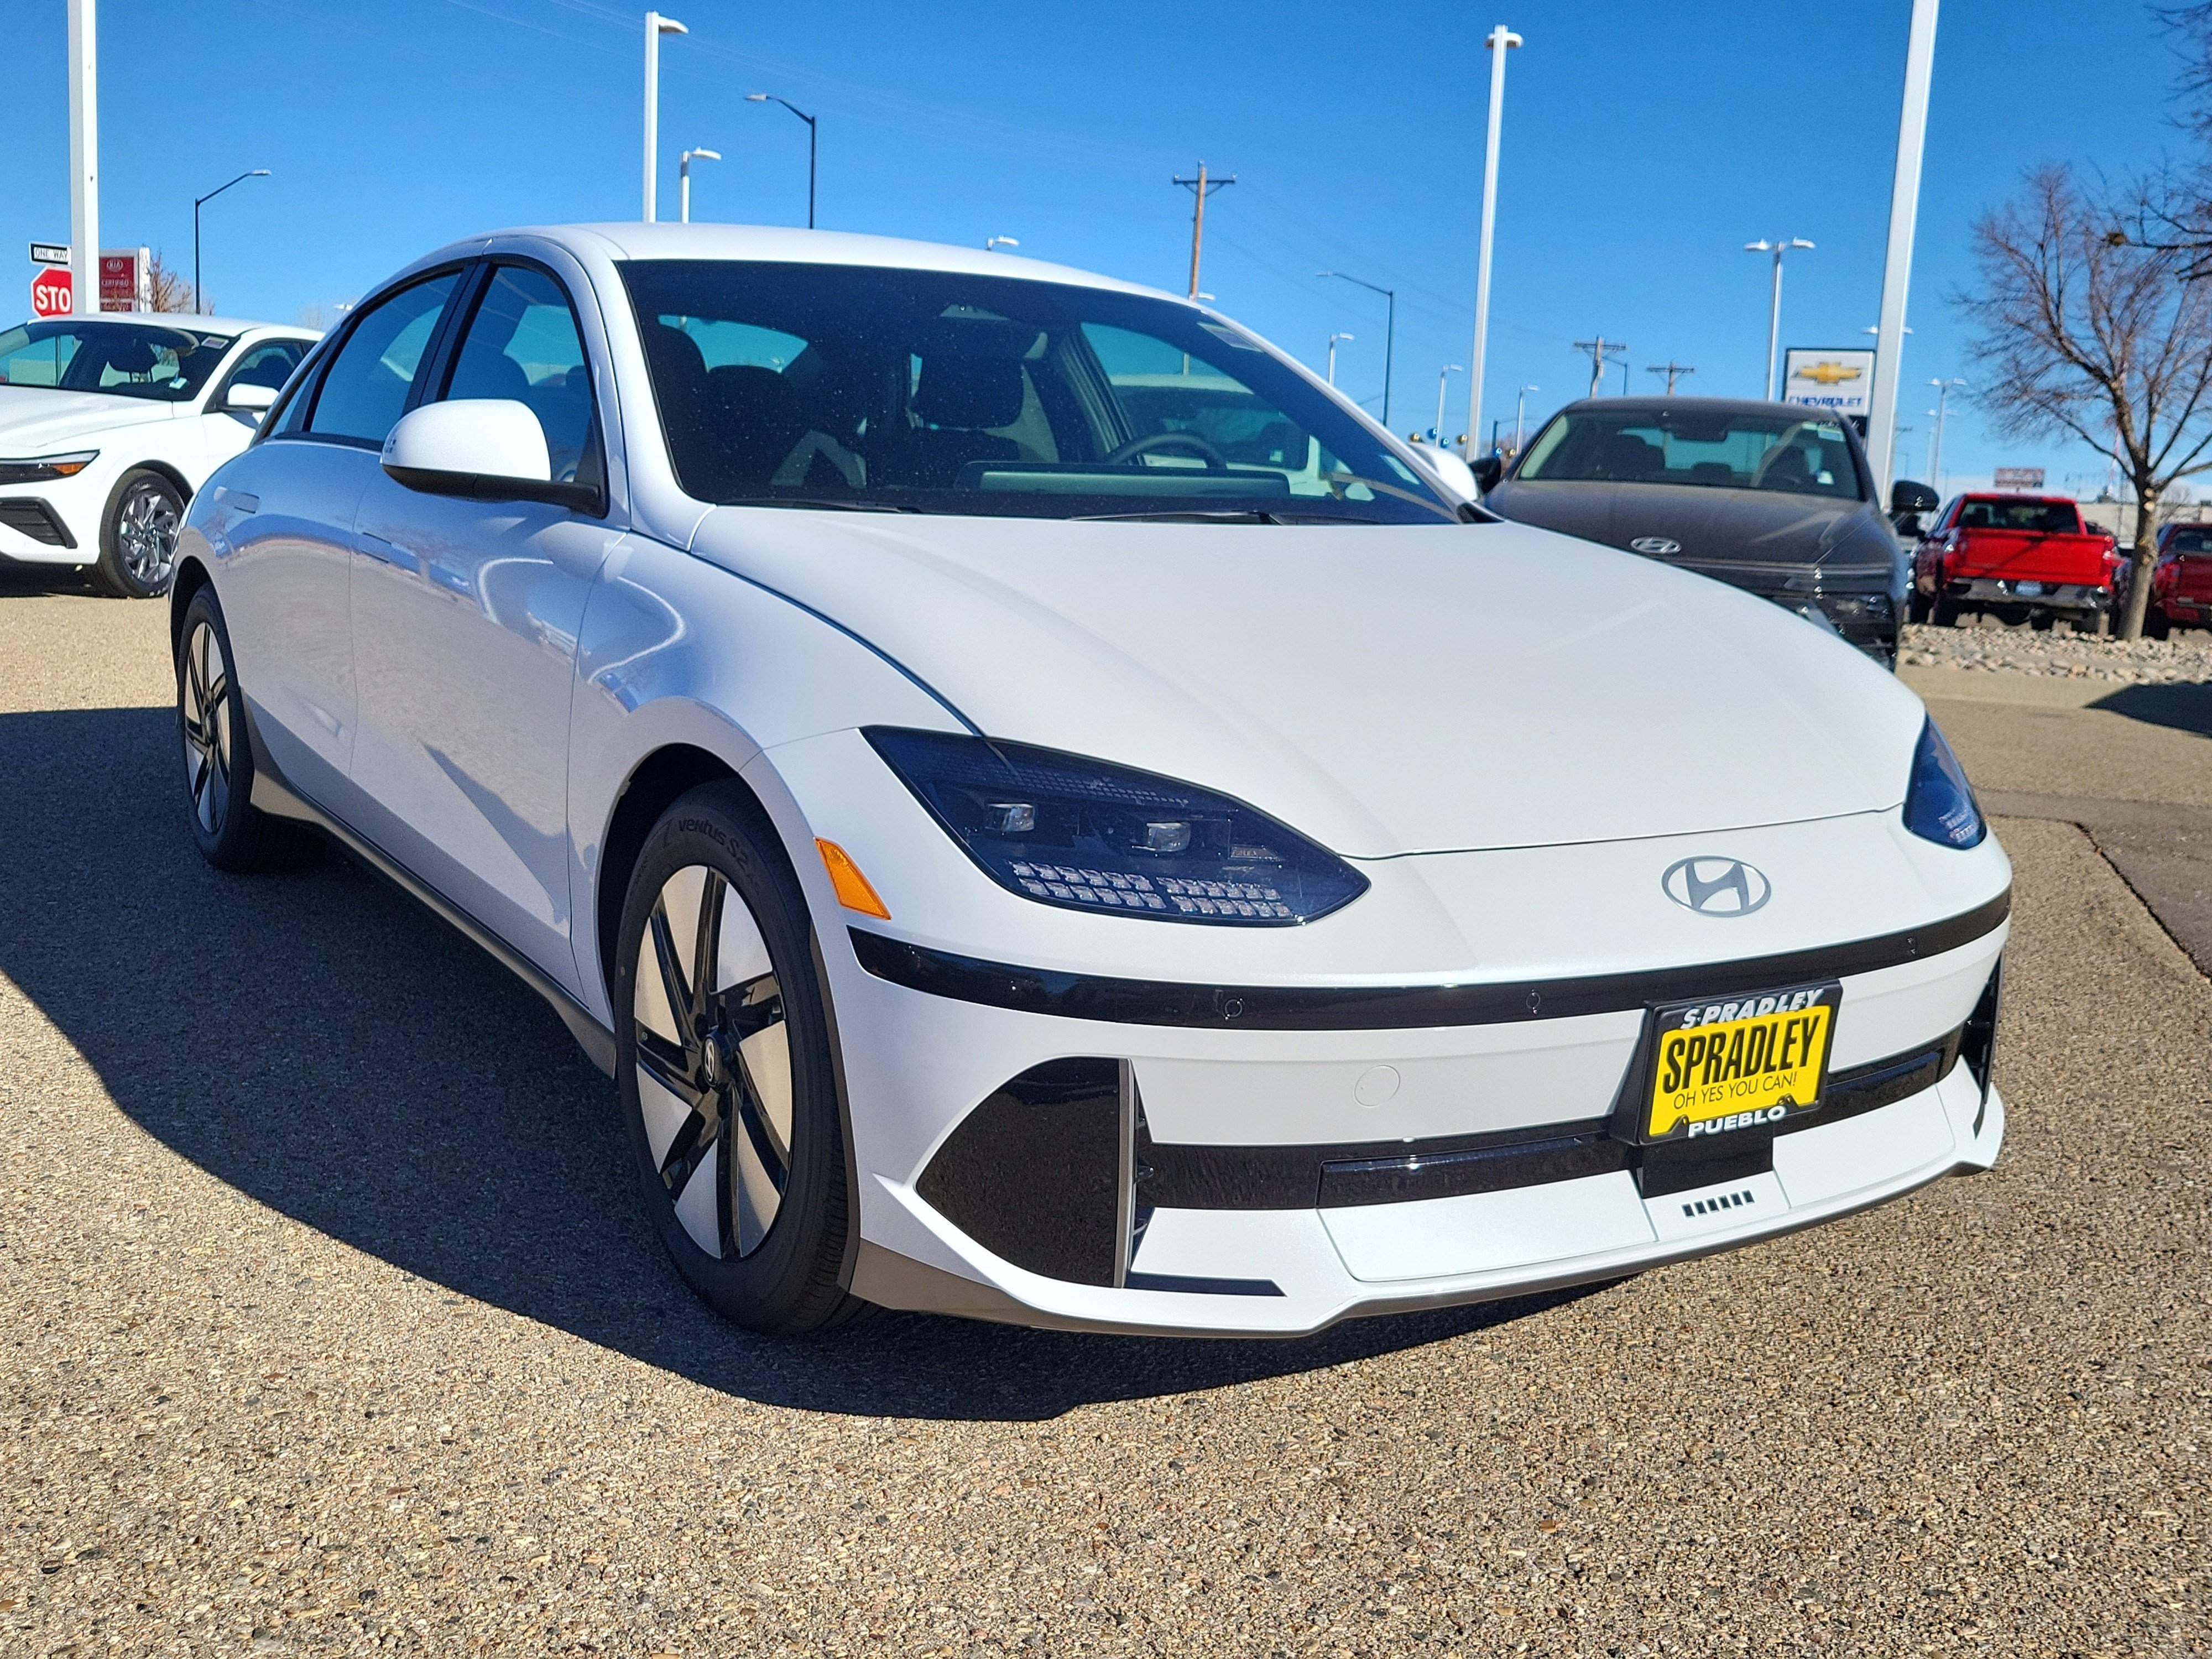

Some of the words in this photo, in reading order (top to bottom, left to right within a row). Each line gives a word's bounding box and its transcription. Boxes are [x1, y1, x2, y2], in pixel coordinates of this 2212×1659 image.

[35, 247, 49, 258] ONE
[54, 249, 67, 259] WAY
[36, 285, 71, 312] STO
[1788, 396, 1863, 407] CHEVROLET
[1680, 988, 1824, 1029] SPRADLEY
[1662, 1015, 1821, 1094] SPRADLEY
[1674, 1091, 1696, 1109] OH
[1702, 1086, 1724, 1104] YES
[1729, 1078, 1758, 1098] YOU
[1763, 1071, 1797, 1091] CAN!
[1688, 1105, 1787, 1139] PUEBLO
